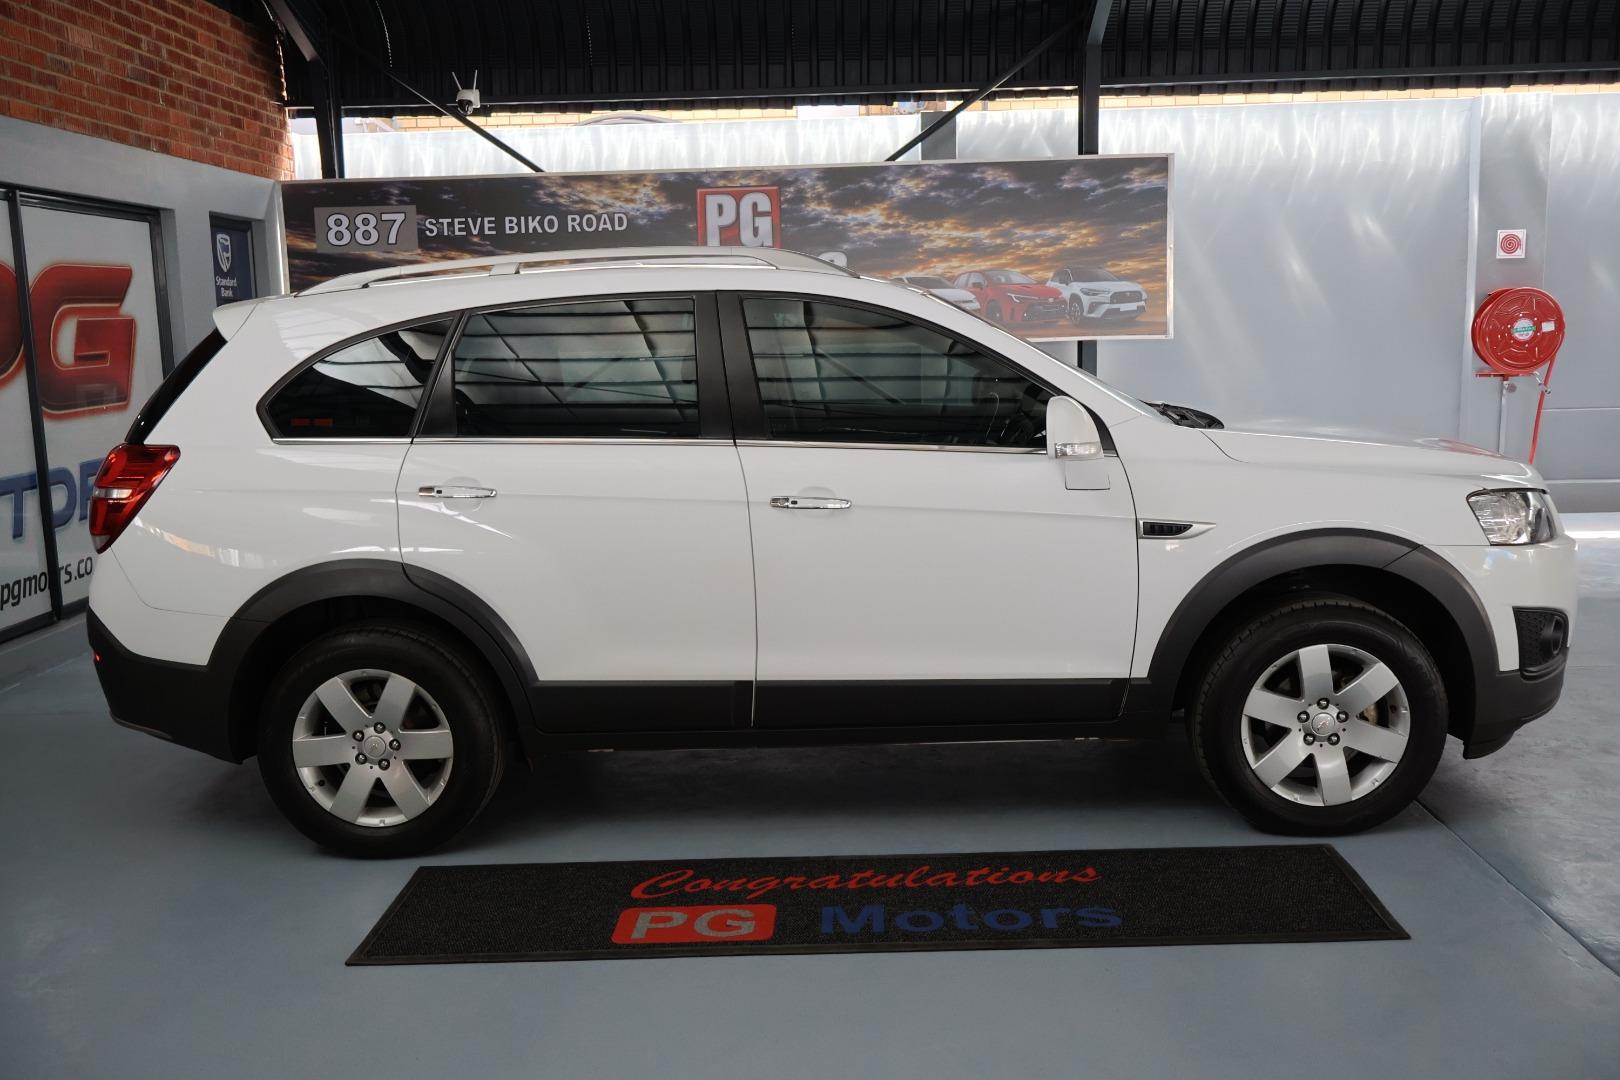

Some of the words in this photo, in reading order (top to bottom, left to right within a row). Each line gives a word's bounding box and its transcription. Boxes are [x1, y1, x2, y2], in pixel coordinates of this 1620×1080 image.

[326, 212, 406, 246] 887
[424, 216, 497, 237] STEVE
[504, 215, 559, 235] BIKO
[567, 213, 628, 233] ROAD
[705, 191, 774, 248] PG
[215, 275, 237, 287] Standard
[220, 287, 233, 297] Bank
[0, 556, 93, 610] pgmors.co
[630, 866, 1102, 899] Congratulations
[630, 908, 757, 939] PG
[819, 902, 1123, 935] Motors
